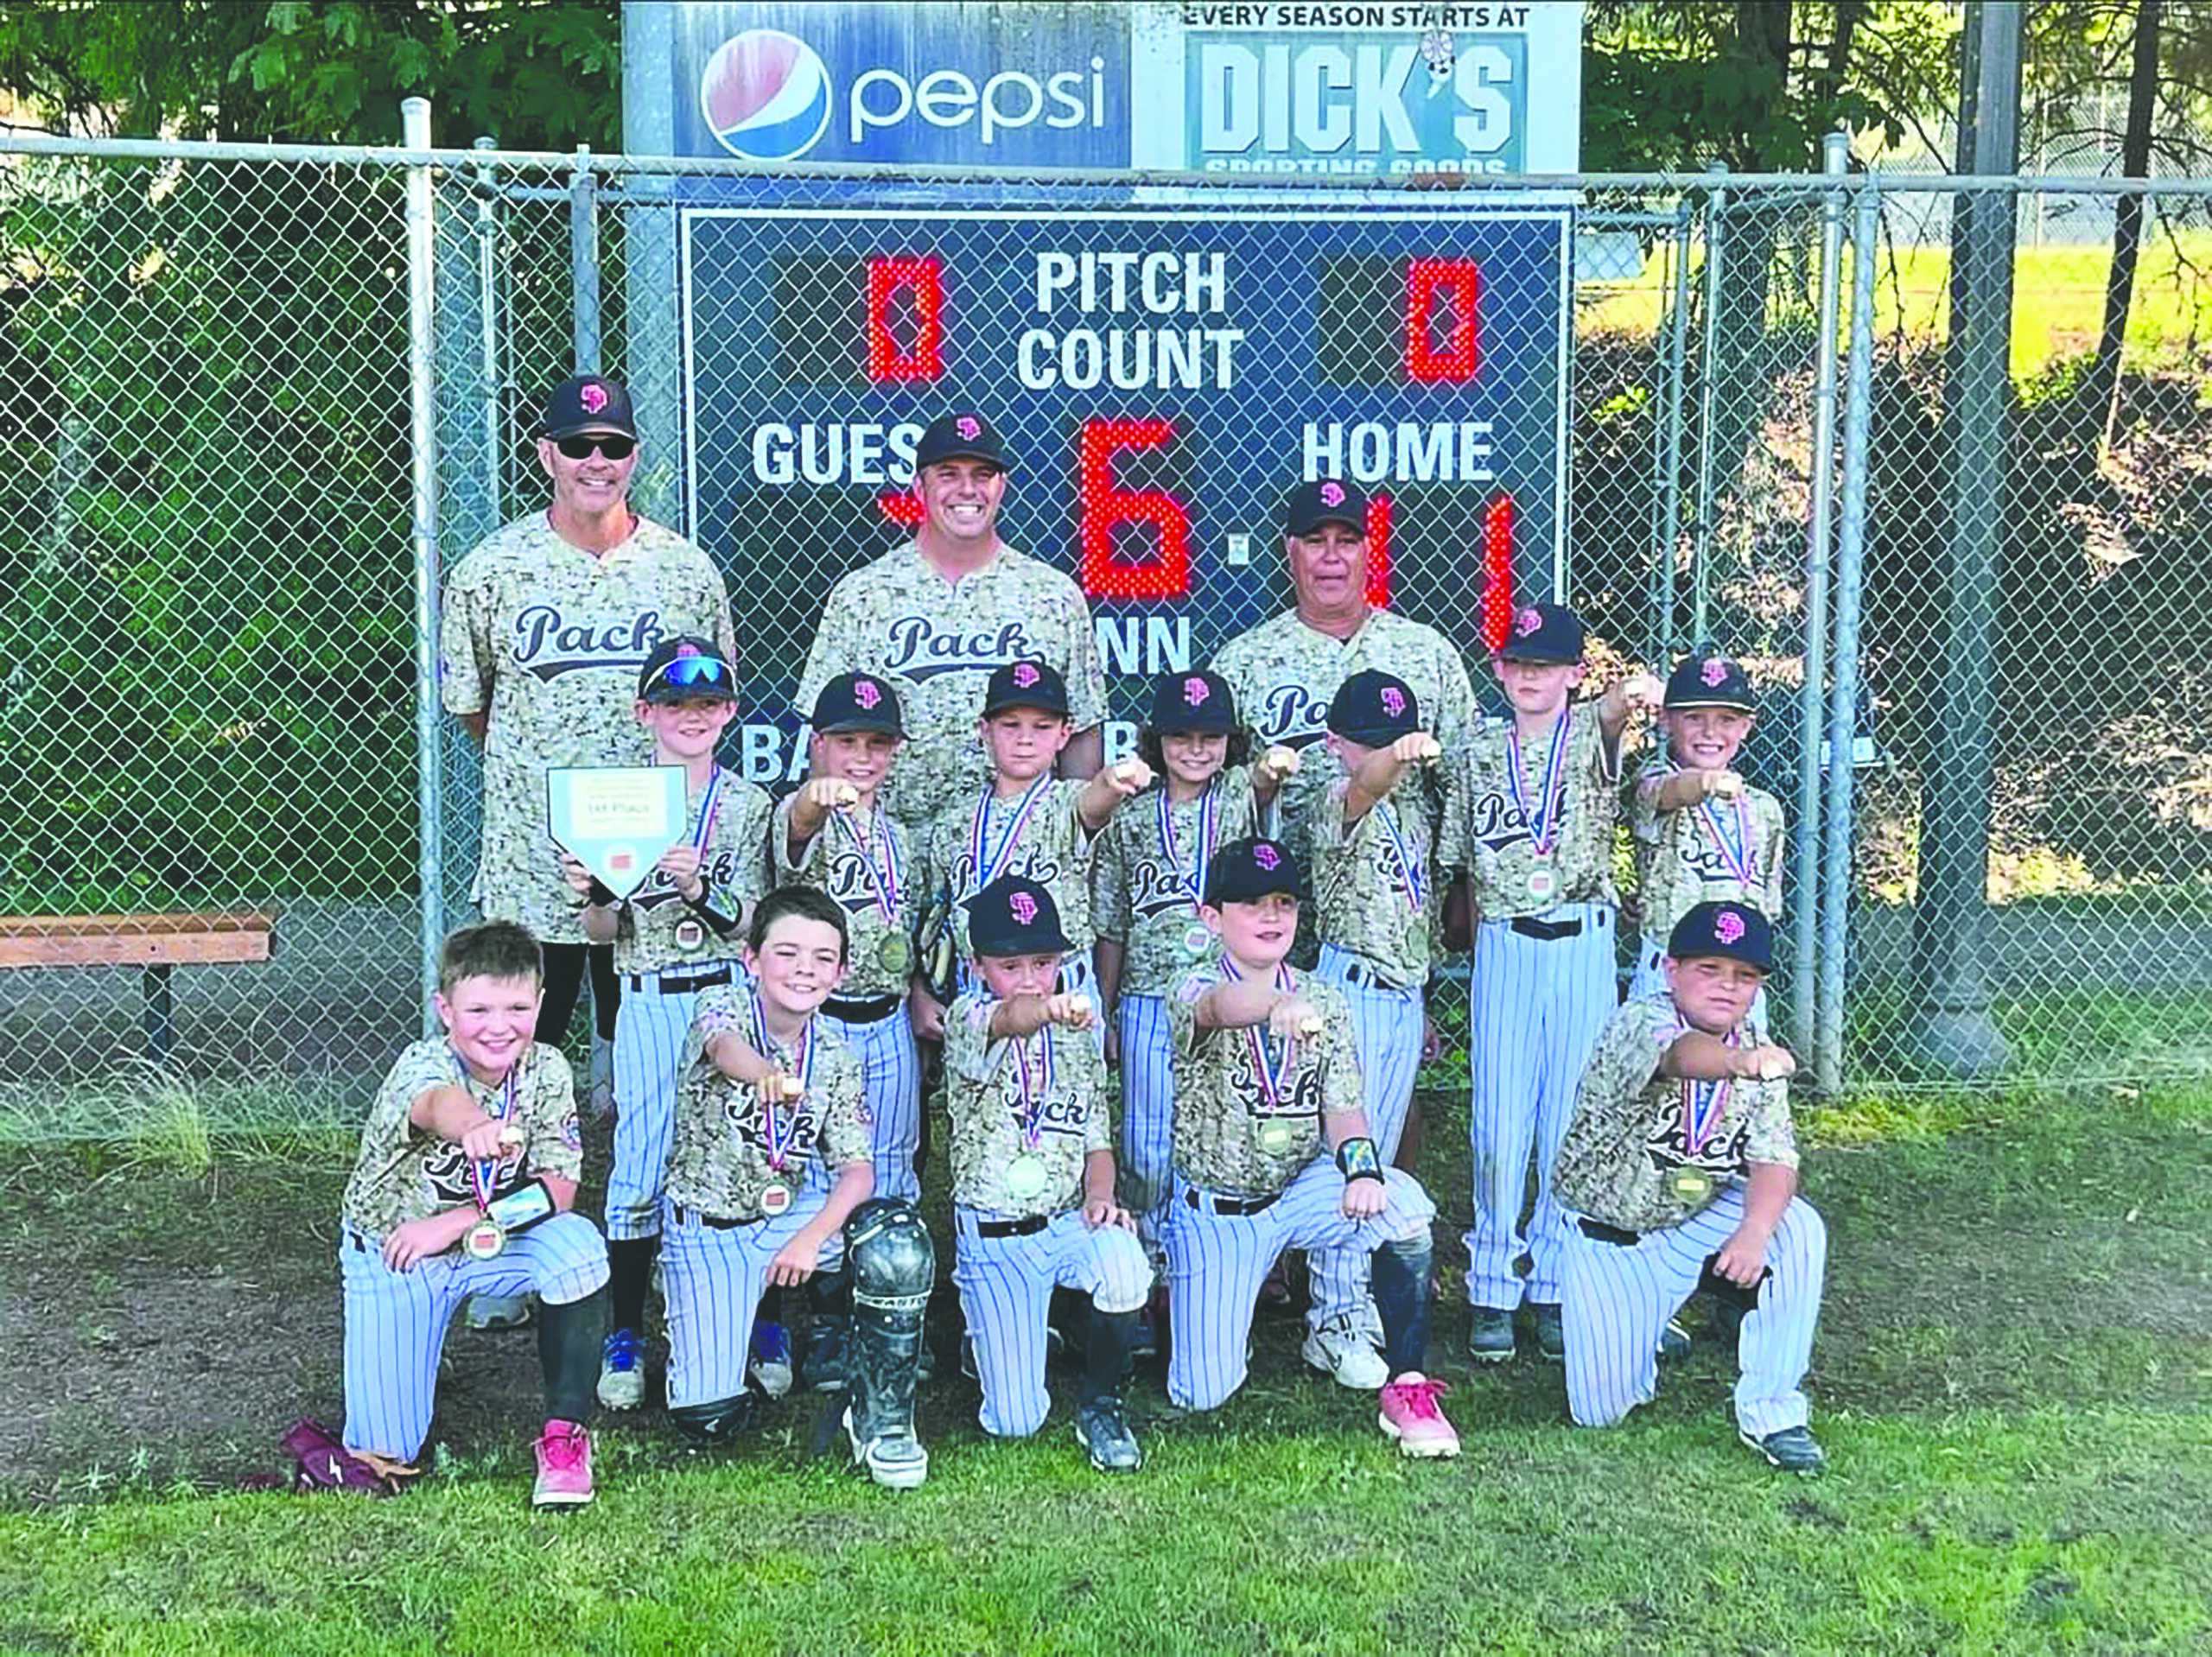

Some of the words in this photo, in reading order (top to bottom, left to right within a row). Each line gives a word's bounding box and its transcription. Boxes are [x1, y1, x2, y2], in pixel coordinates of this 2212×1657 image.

[1185, 7, 1268, 26] EVERY
[1277, 7, 1382, 27] SEASON
[1391, 8, 1489, 26] STARTS
[1497, 9, 1529, 26] AT
[851, 56, 1104, 144] pepsi
[1201, 43, 1513, 154] DICK'S
[1037, 251, 1225, 313] PITCH
[867, 258, 941, 379] 0
[1408, 259, 1478, 380] 0
[1018, 328, 1244, 390] COUNT
[753, 423, 925, 484] GUES
[1303, 422, 1493, 482] HOME
[1080, 419, 1190, 599] 6
[512, 606, 664, 662] Pack
[884, 616, 1047, 669] Pack
[1095, 617, 1191, 674] NN
[1261, 686, 1327, 737] Pa
[742, 724, 810, 782] BA
[1131, 862, 1199, 908] Pac
